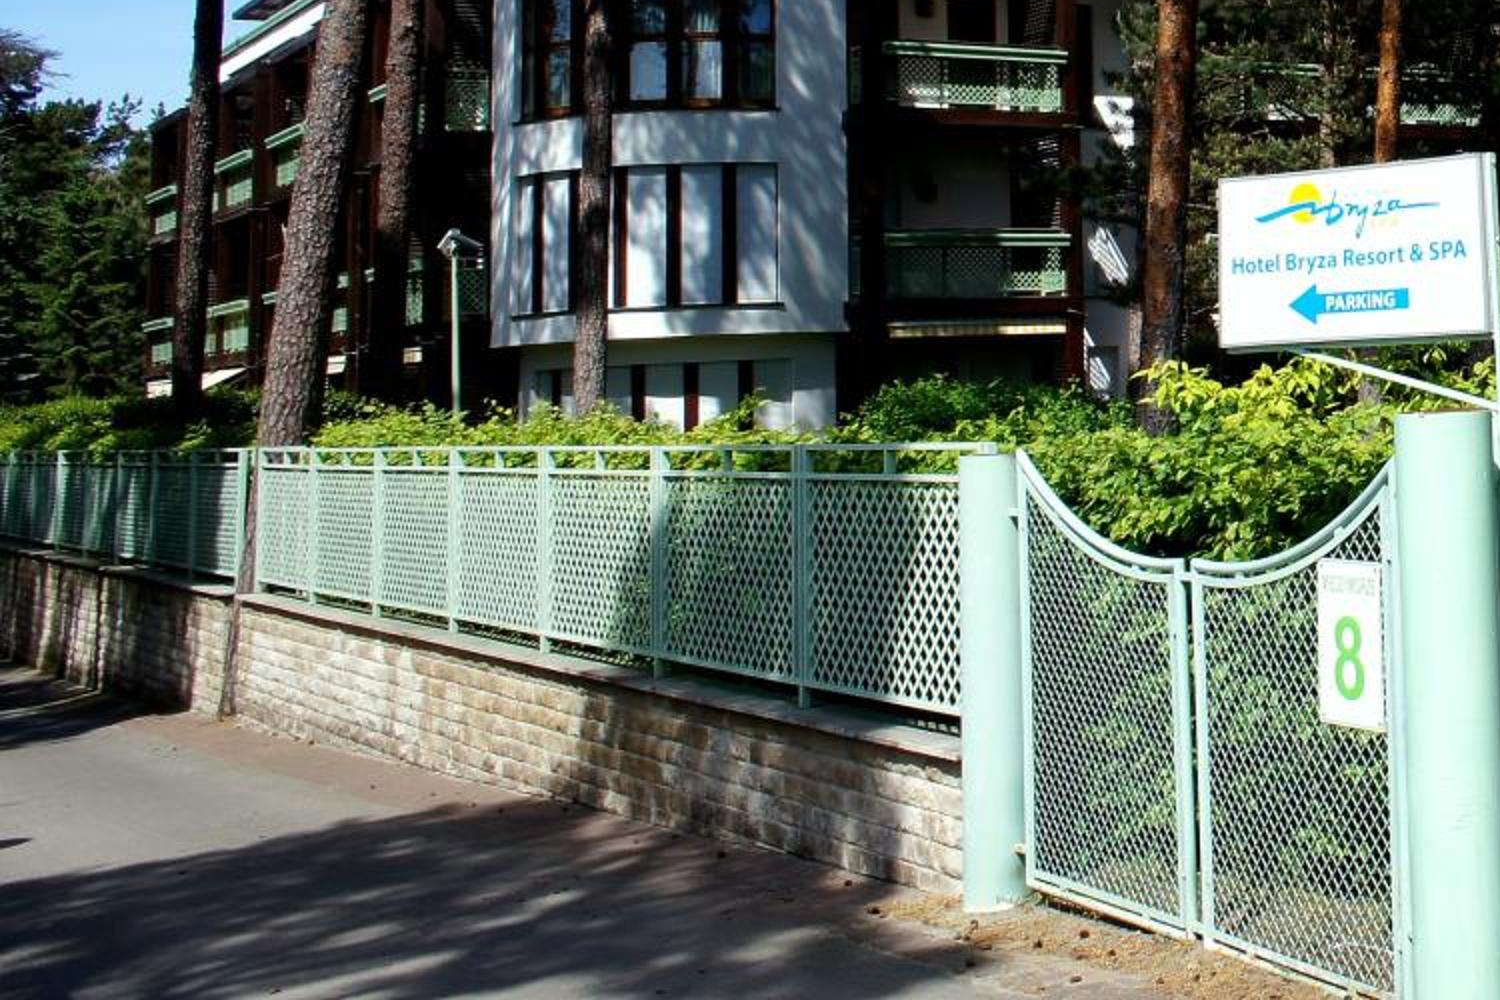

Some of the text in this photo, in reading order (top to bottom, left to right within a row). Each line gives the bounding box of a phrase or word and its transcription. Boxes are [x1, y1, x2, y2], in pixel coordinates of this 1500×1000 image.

[1325, 189, 1408, 239] bryza
[1231, 239, 1467, 275] Hotel Bryza Resort & SPA
[1324, 291, 1396, 311] PARKING
[1335, 615, 1365, 701] 8
